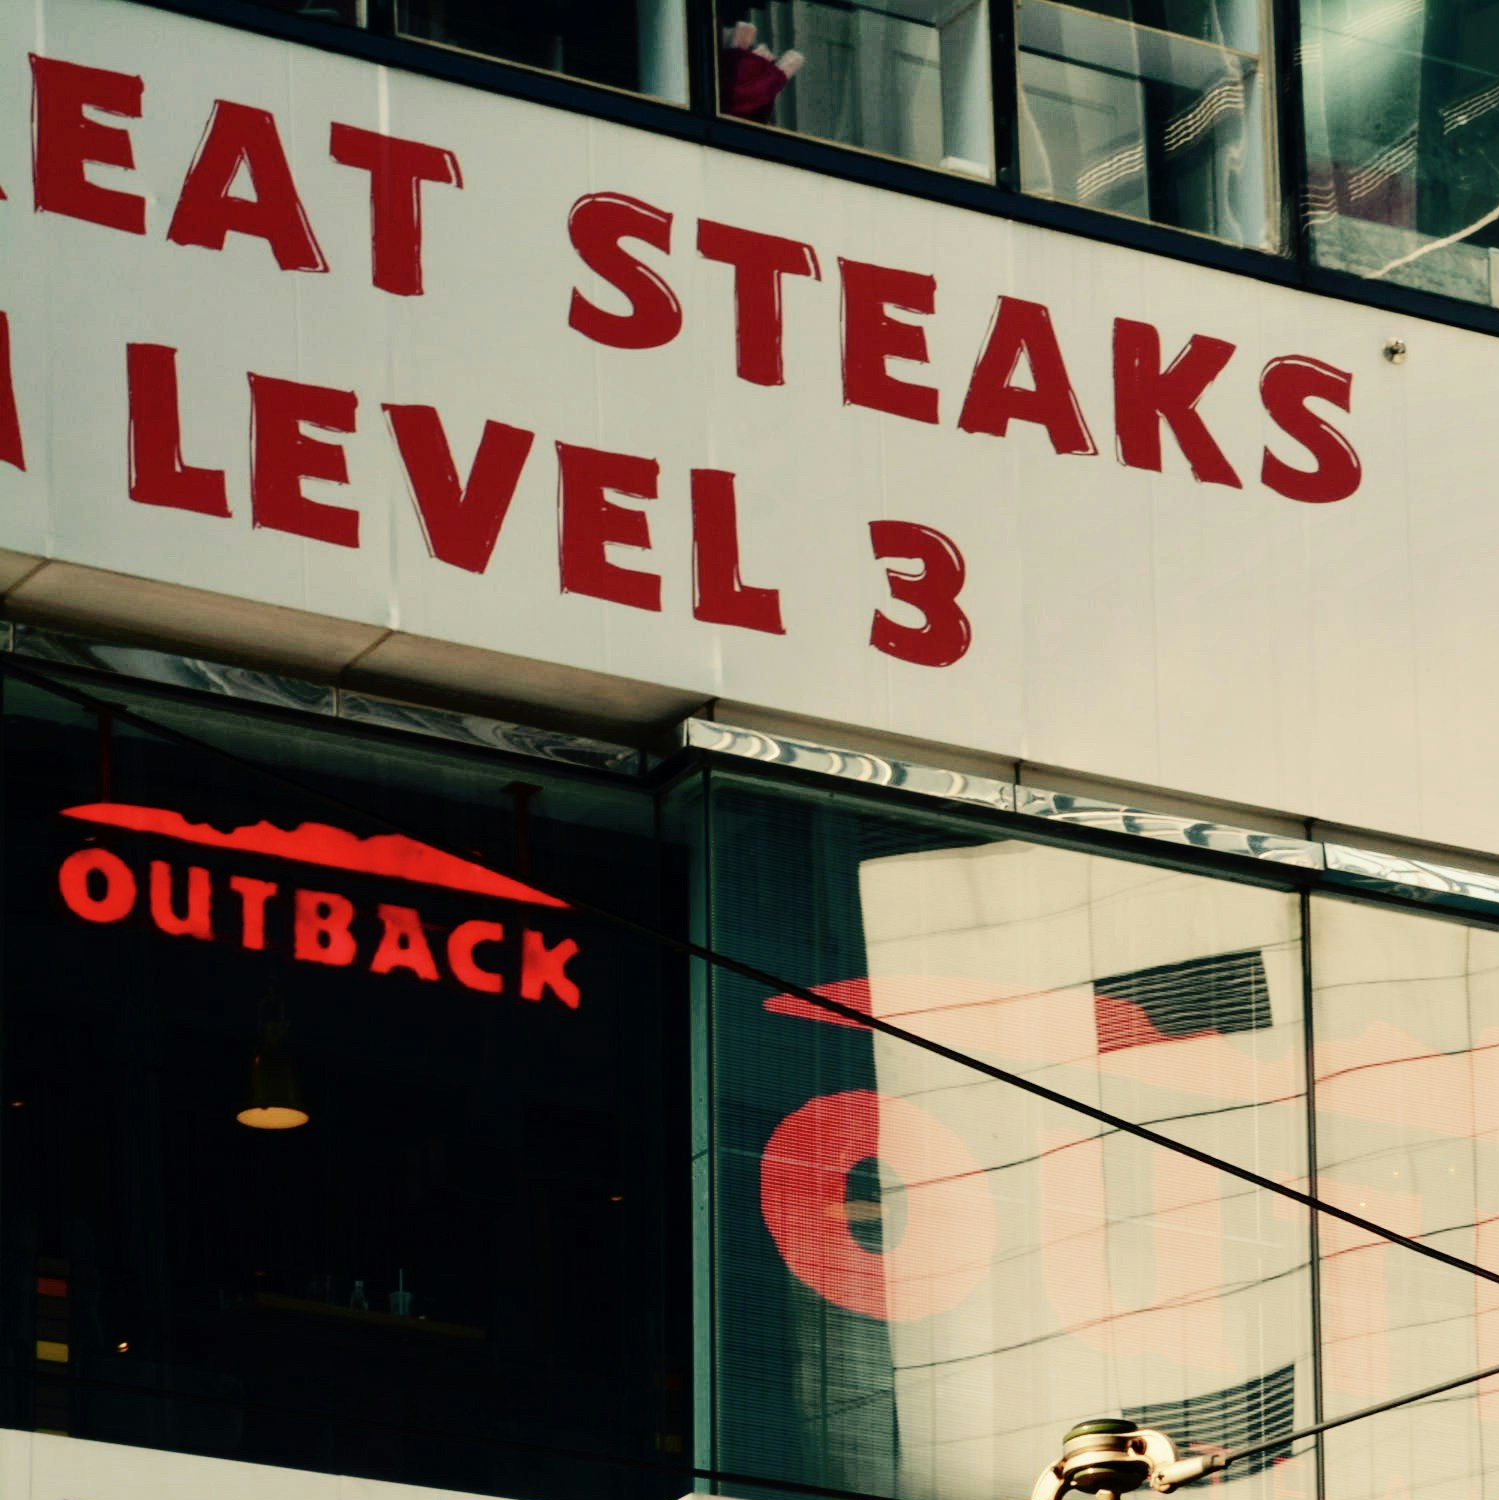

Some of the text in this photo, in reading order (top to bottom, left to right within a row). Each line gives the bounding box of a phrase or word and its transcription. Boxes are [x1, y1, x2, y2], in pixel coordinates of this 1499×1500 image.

[0, 53, 1363, 505] EAT STEAKS
[126, 342, 787, 636] LEVEL
[868, 520, 972, 668] 3
[58, 848, 581, 1010] OUTBACK
